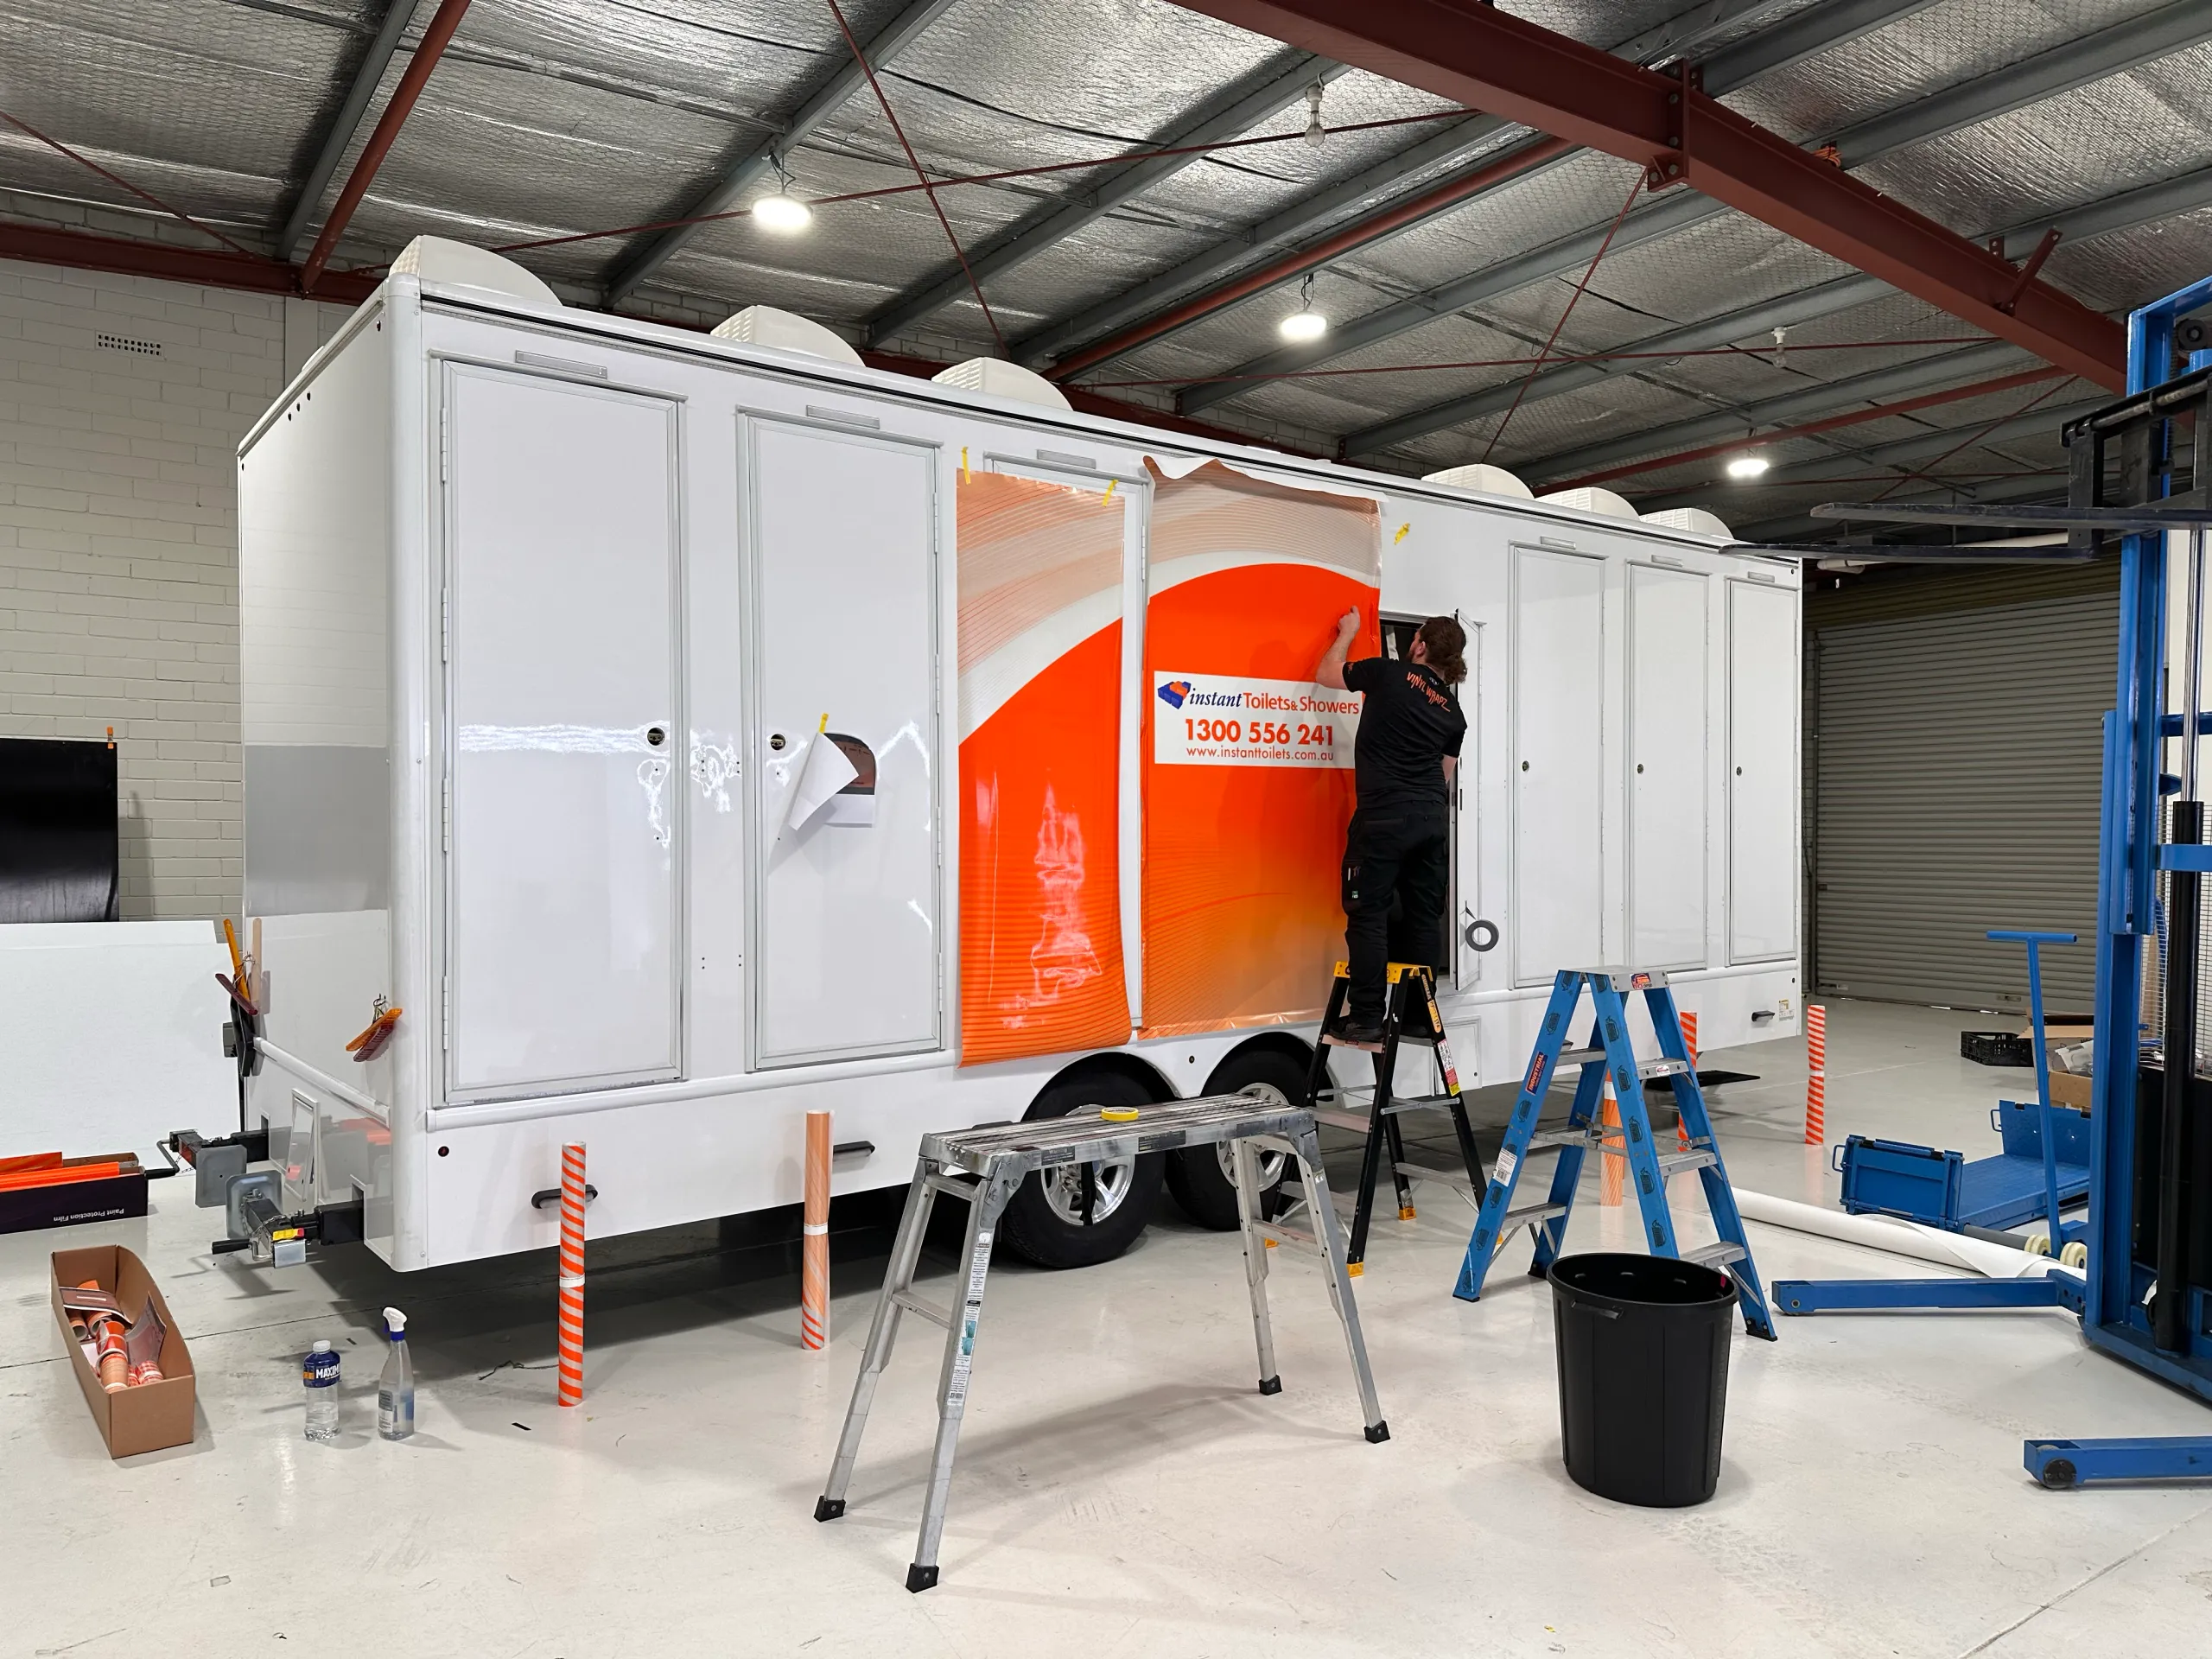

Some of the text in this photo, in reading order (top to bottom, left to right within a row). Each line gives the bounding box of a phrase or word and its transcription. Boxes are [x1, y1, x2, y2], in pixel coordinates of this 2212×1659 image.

[1189, 688, 1243, 708] instant
[1299, 696, 1360, 715] Showers
[1407, 671, 1427, 693] VINYL
[1424, 685, 1451, 713] WRAPZ
[1185, 718, 1333, 746] 1300 556 241
[1186, 745, 1334, 761] www.instanttoilets.com.au
[1528, 1053, 1545, 1091] INDUSTRIAL
[70, 1211, 105, 1220] Protection
